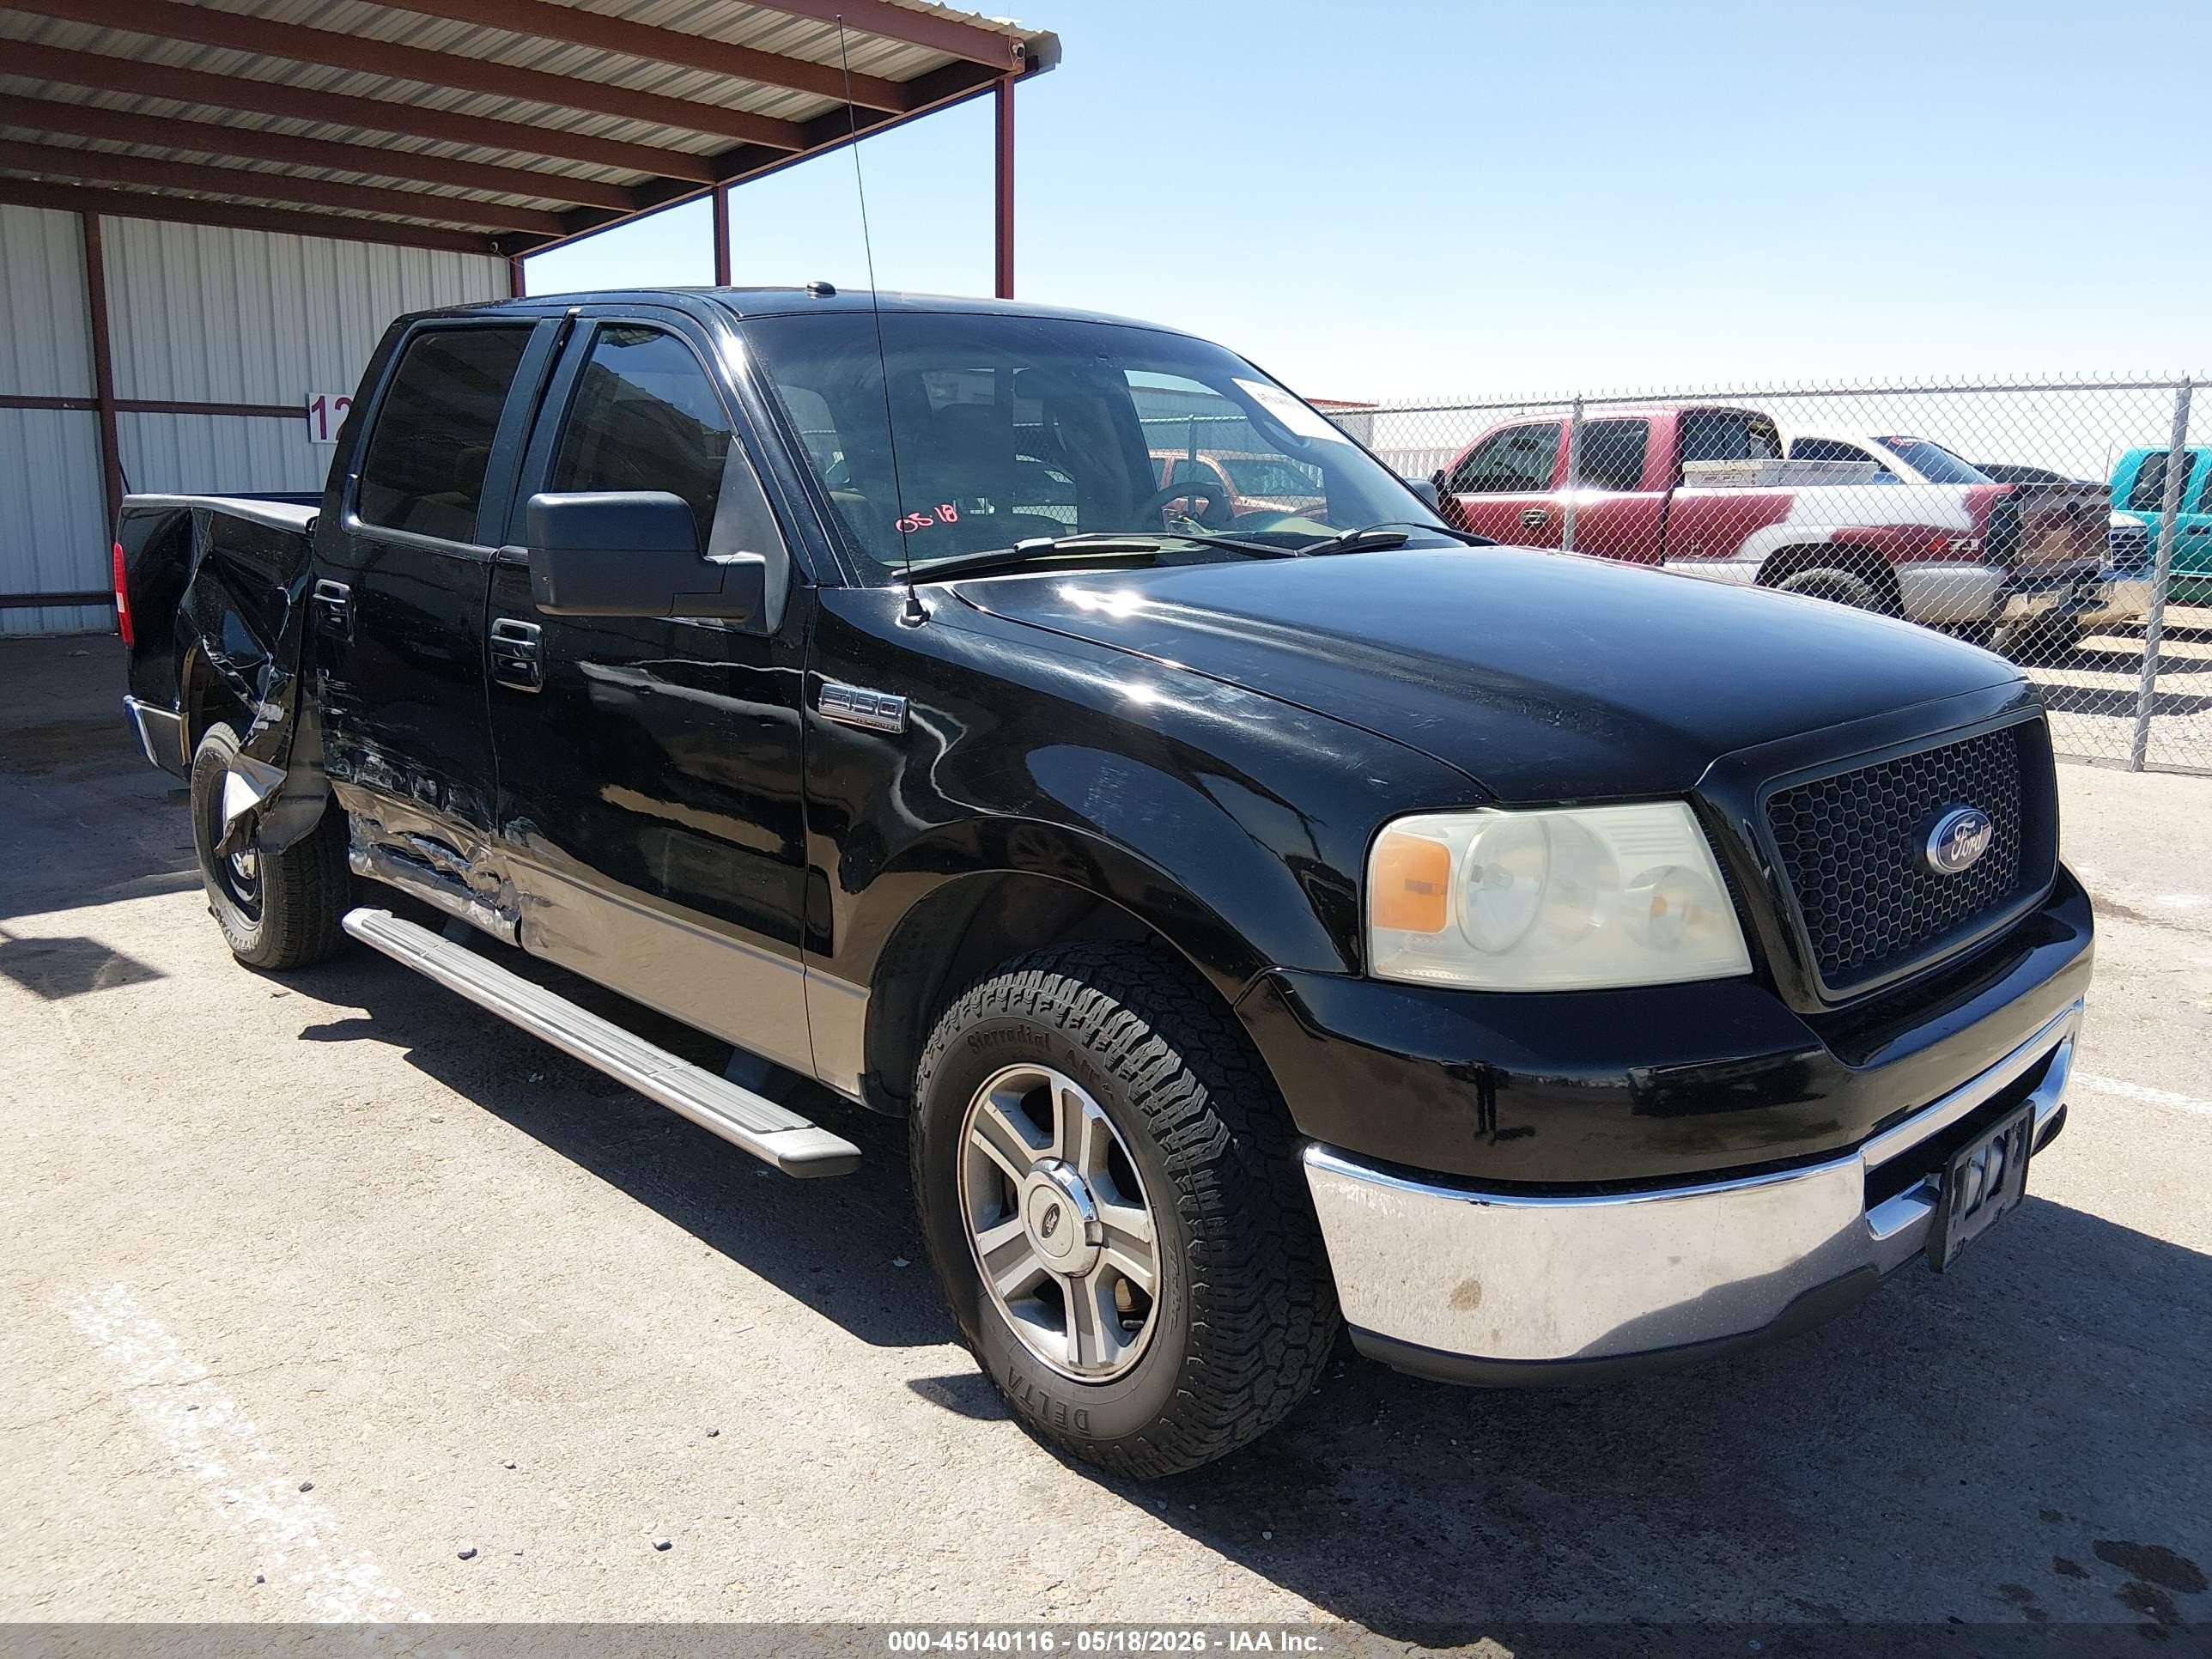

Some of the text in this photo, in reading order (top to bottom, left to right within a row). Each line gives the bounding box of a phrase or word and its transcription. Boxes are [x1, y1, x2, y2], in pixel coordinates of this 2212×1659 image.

[933, 503, 958, 523] 18
[1950, 819, 1984, 862] Ford
[1007, 1365, 1092, 1436] DELTA
